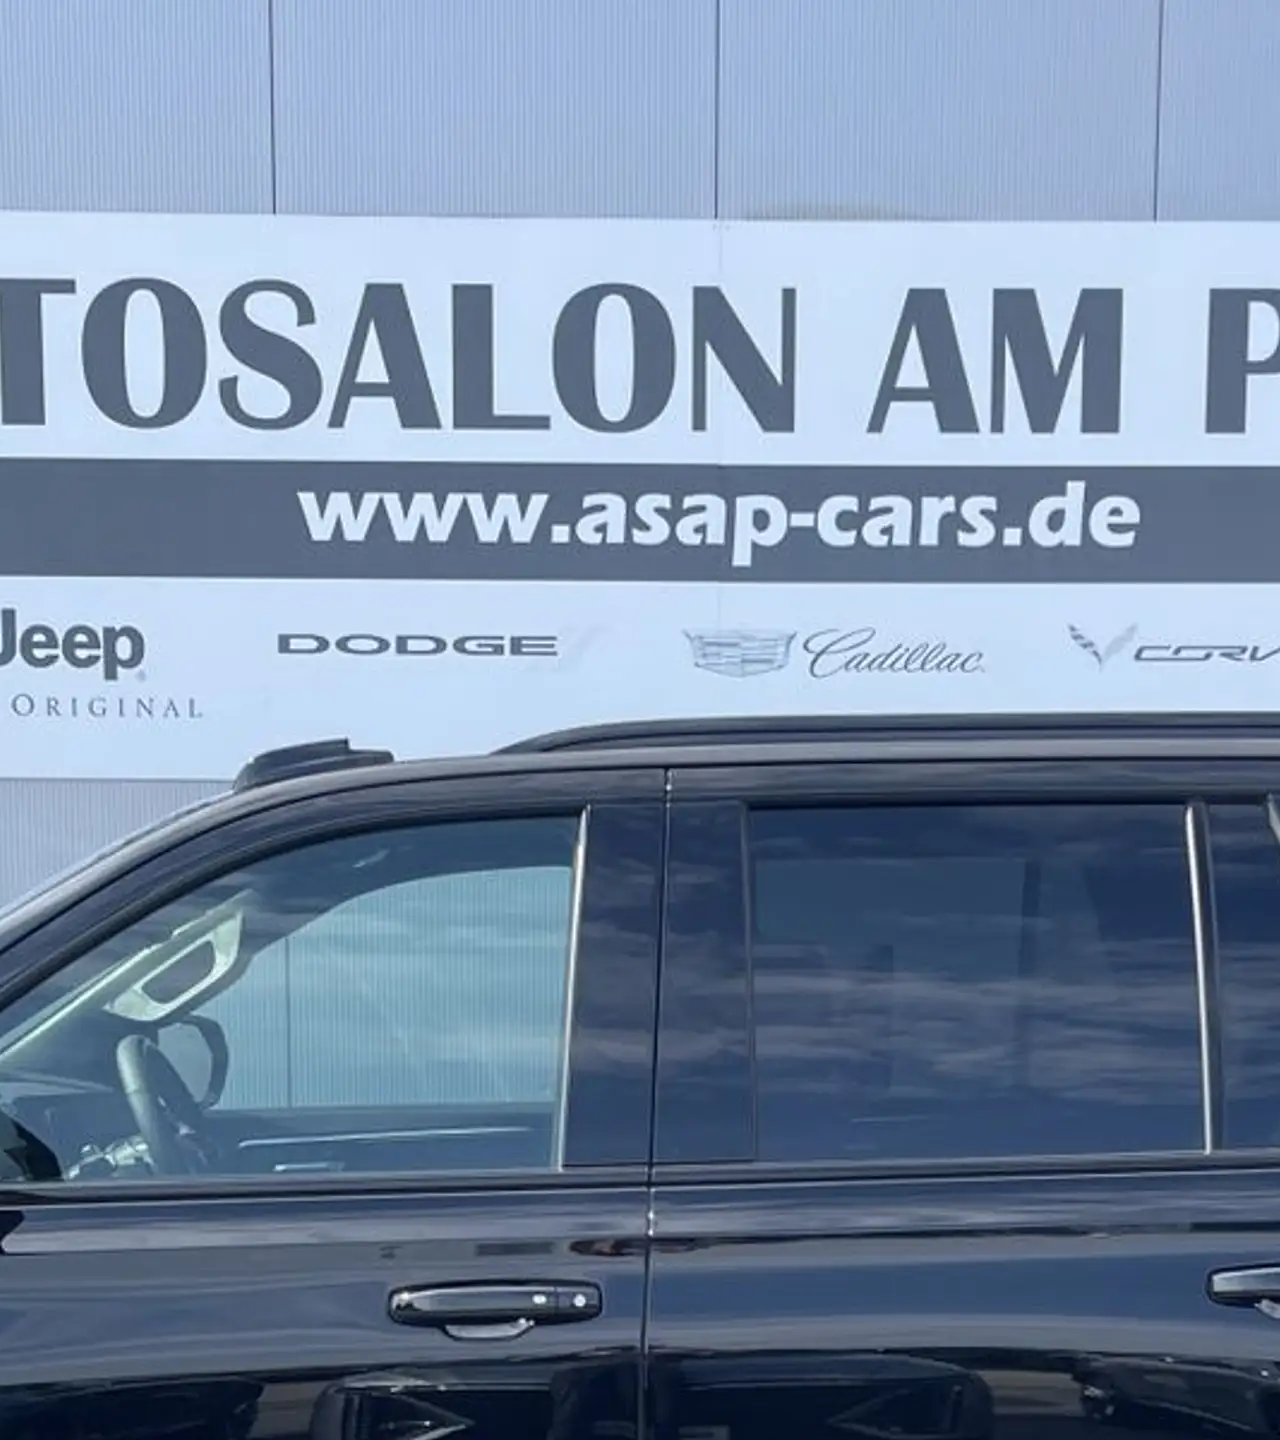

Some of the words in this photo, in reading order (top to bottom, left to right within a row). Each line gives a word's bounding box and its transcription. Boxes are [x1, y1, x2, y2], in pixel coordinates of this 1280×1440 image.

[866, 288, 1123, 434] AM
[297, 481, 1140, 566] www.asap-cars.de
[277, 633, 558, 657] DODGE
[802, 626, 984, 679] Cadillac
